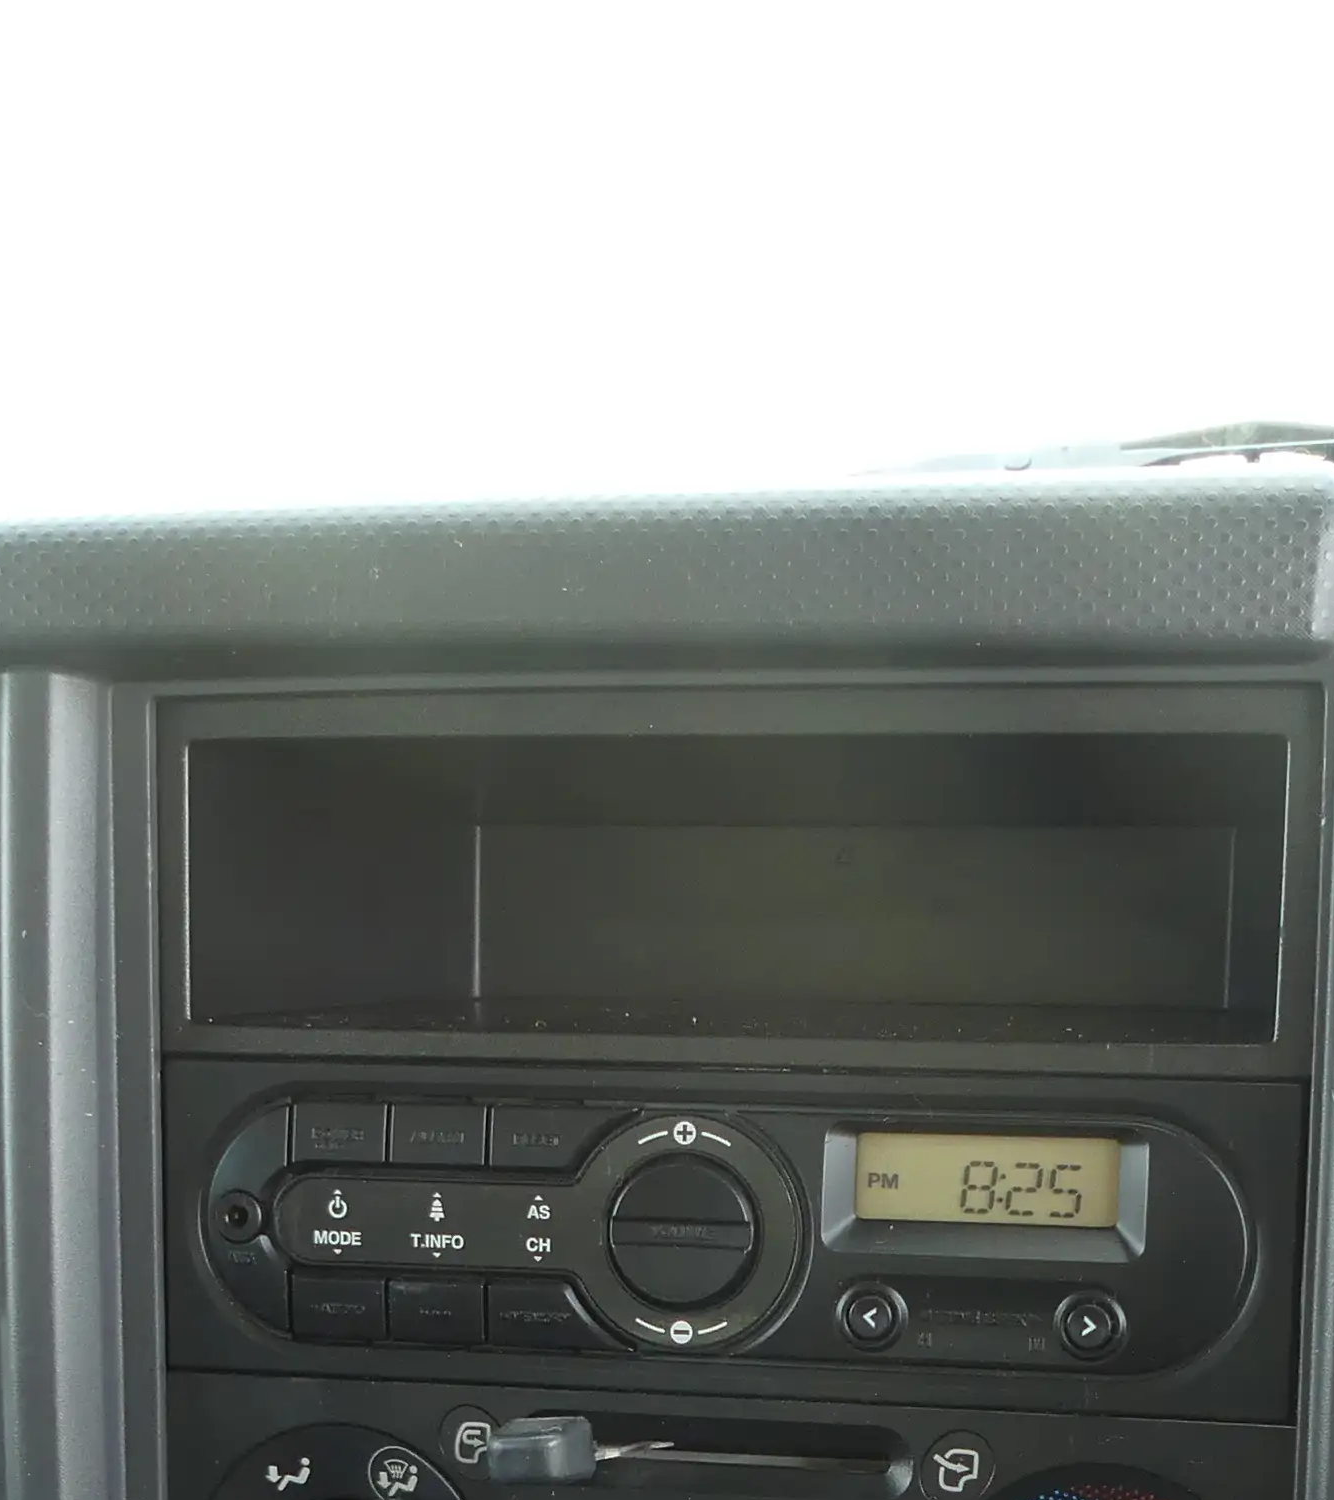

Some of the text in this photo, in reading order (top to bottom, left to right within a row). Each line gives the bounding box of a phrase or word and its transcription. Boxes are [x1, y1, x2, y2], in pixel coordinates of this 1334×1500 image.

[867, 1160, 1082, 1219] PM 8:25
[526, 1204, 552, 1221] AS
[313, 1230, 363, 1247] MODE
[409, 1232, 465, 1251] T.INFO
[524, 1236, 552, 1254] CH
